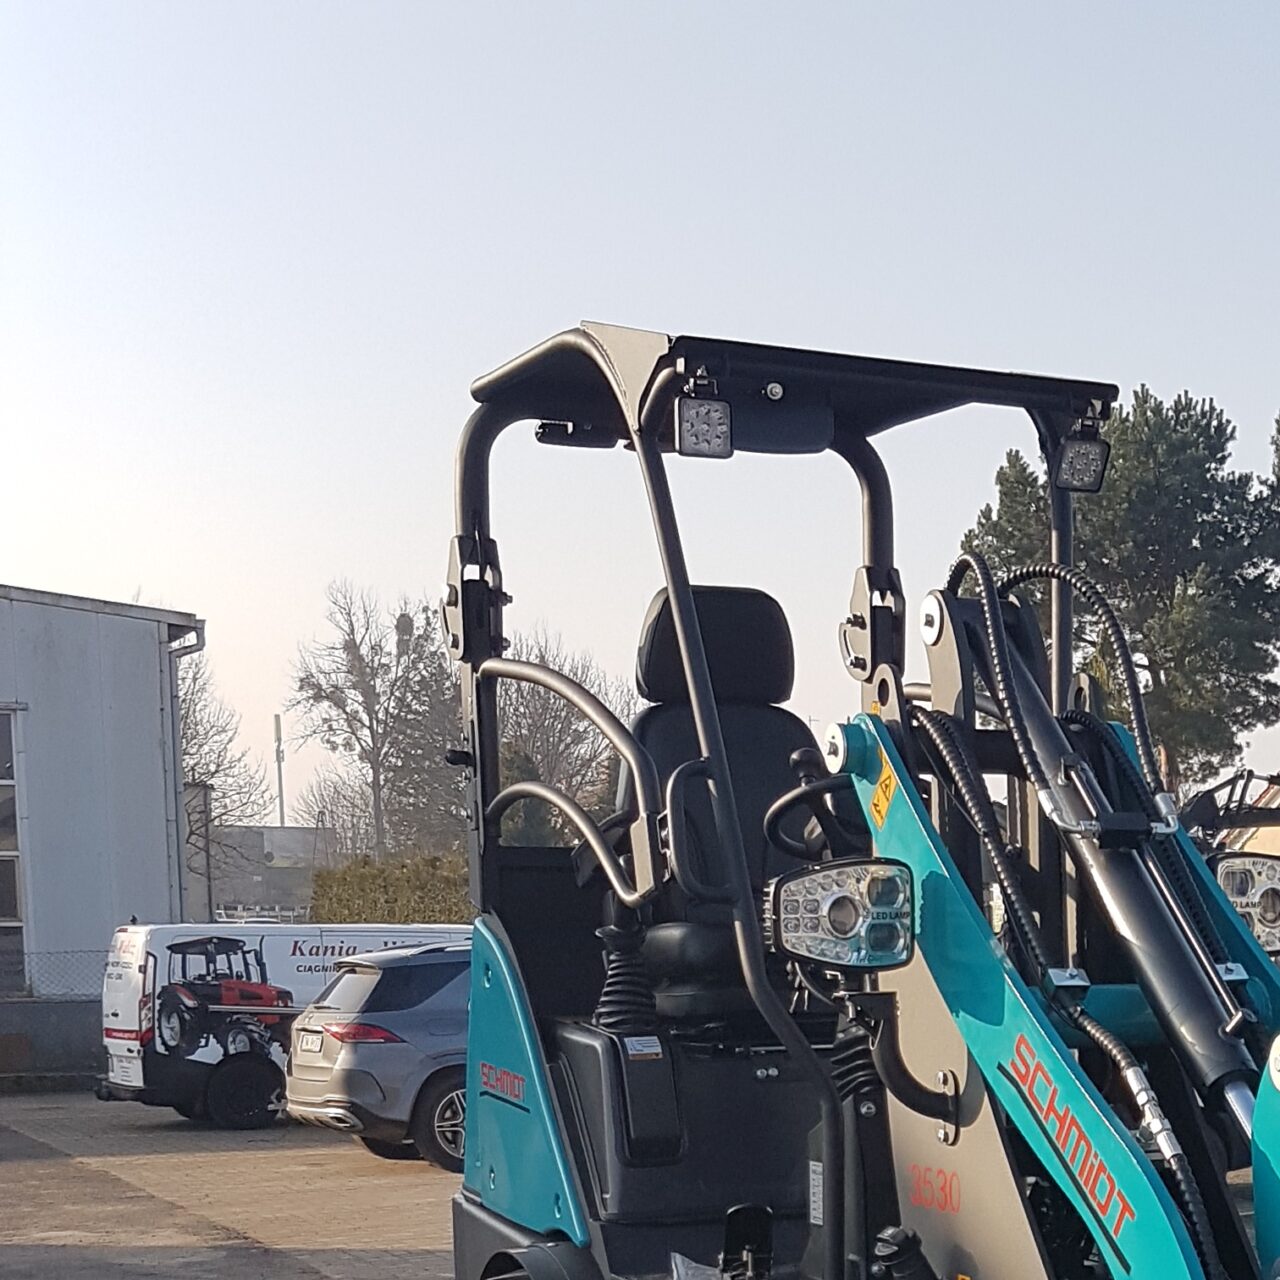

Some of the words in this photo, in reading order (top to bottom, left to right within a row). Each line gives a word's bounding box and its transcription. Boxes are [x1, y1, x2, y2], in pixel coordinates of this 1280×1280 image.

[871, 912, 888, 920] LED
[289, 940, 358, 957] Kania
[296, 964, 337, 975] CIĄGNI
